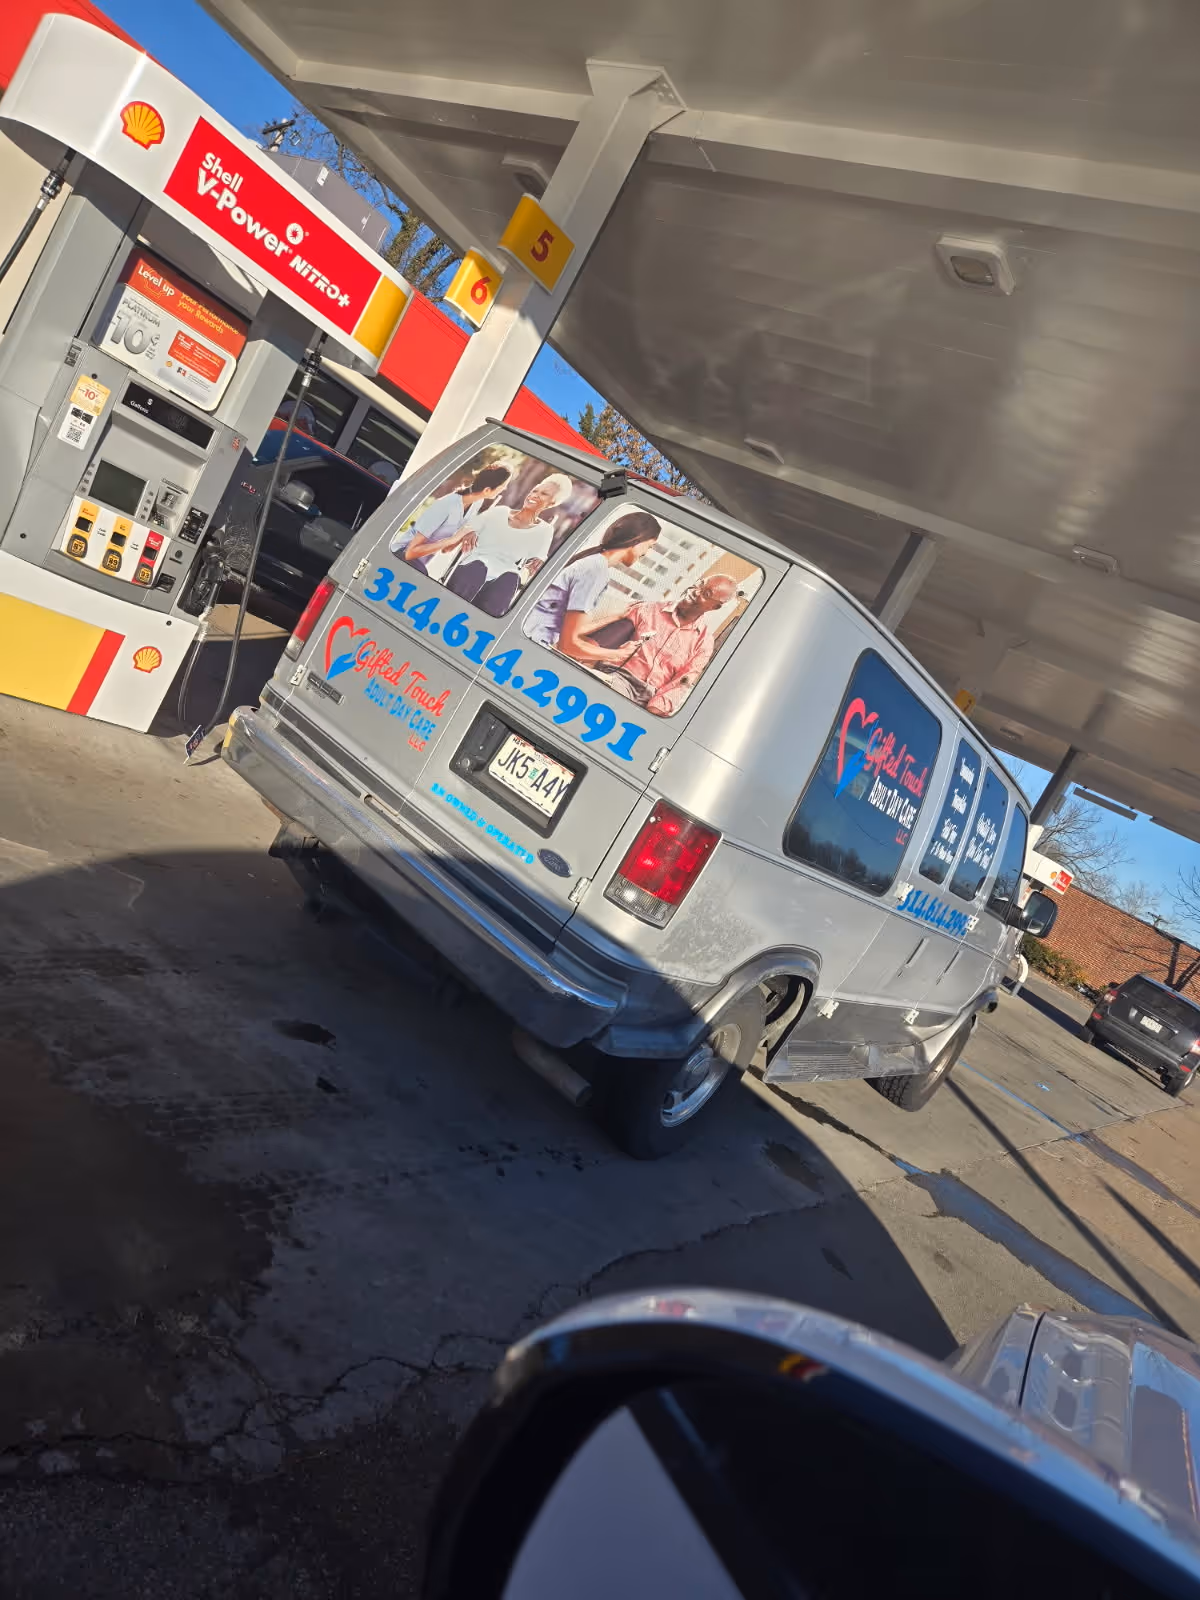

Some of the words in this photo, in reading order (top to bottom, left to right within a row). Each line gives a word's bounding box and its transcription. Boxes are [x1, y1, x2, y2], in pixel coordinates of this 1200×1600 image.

[202, 152, 244, 193] Shell
[530, 229, 555, 262] 5
[138, 264, 162, 288] Level
[162, 282, 175, 297] up
[470, 276, 492, 306] 6
[178, 299, 194, 315] your
[195, 308, 224, 335] Rewards
[354, 640, 410, 686] Gifted
[403, 671, 452, 717] Touch
[363, 567, 647, 762] 314.614.2991
[407, 735, 427, 752] LLC
[864, 727, 907, 779] Gifted
[900, 755, 928, 798] Touch
[497, 747, 535, 779] JK5
[530, 764, 572, 804] A4Y
